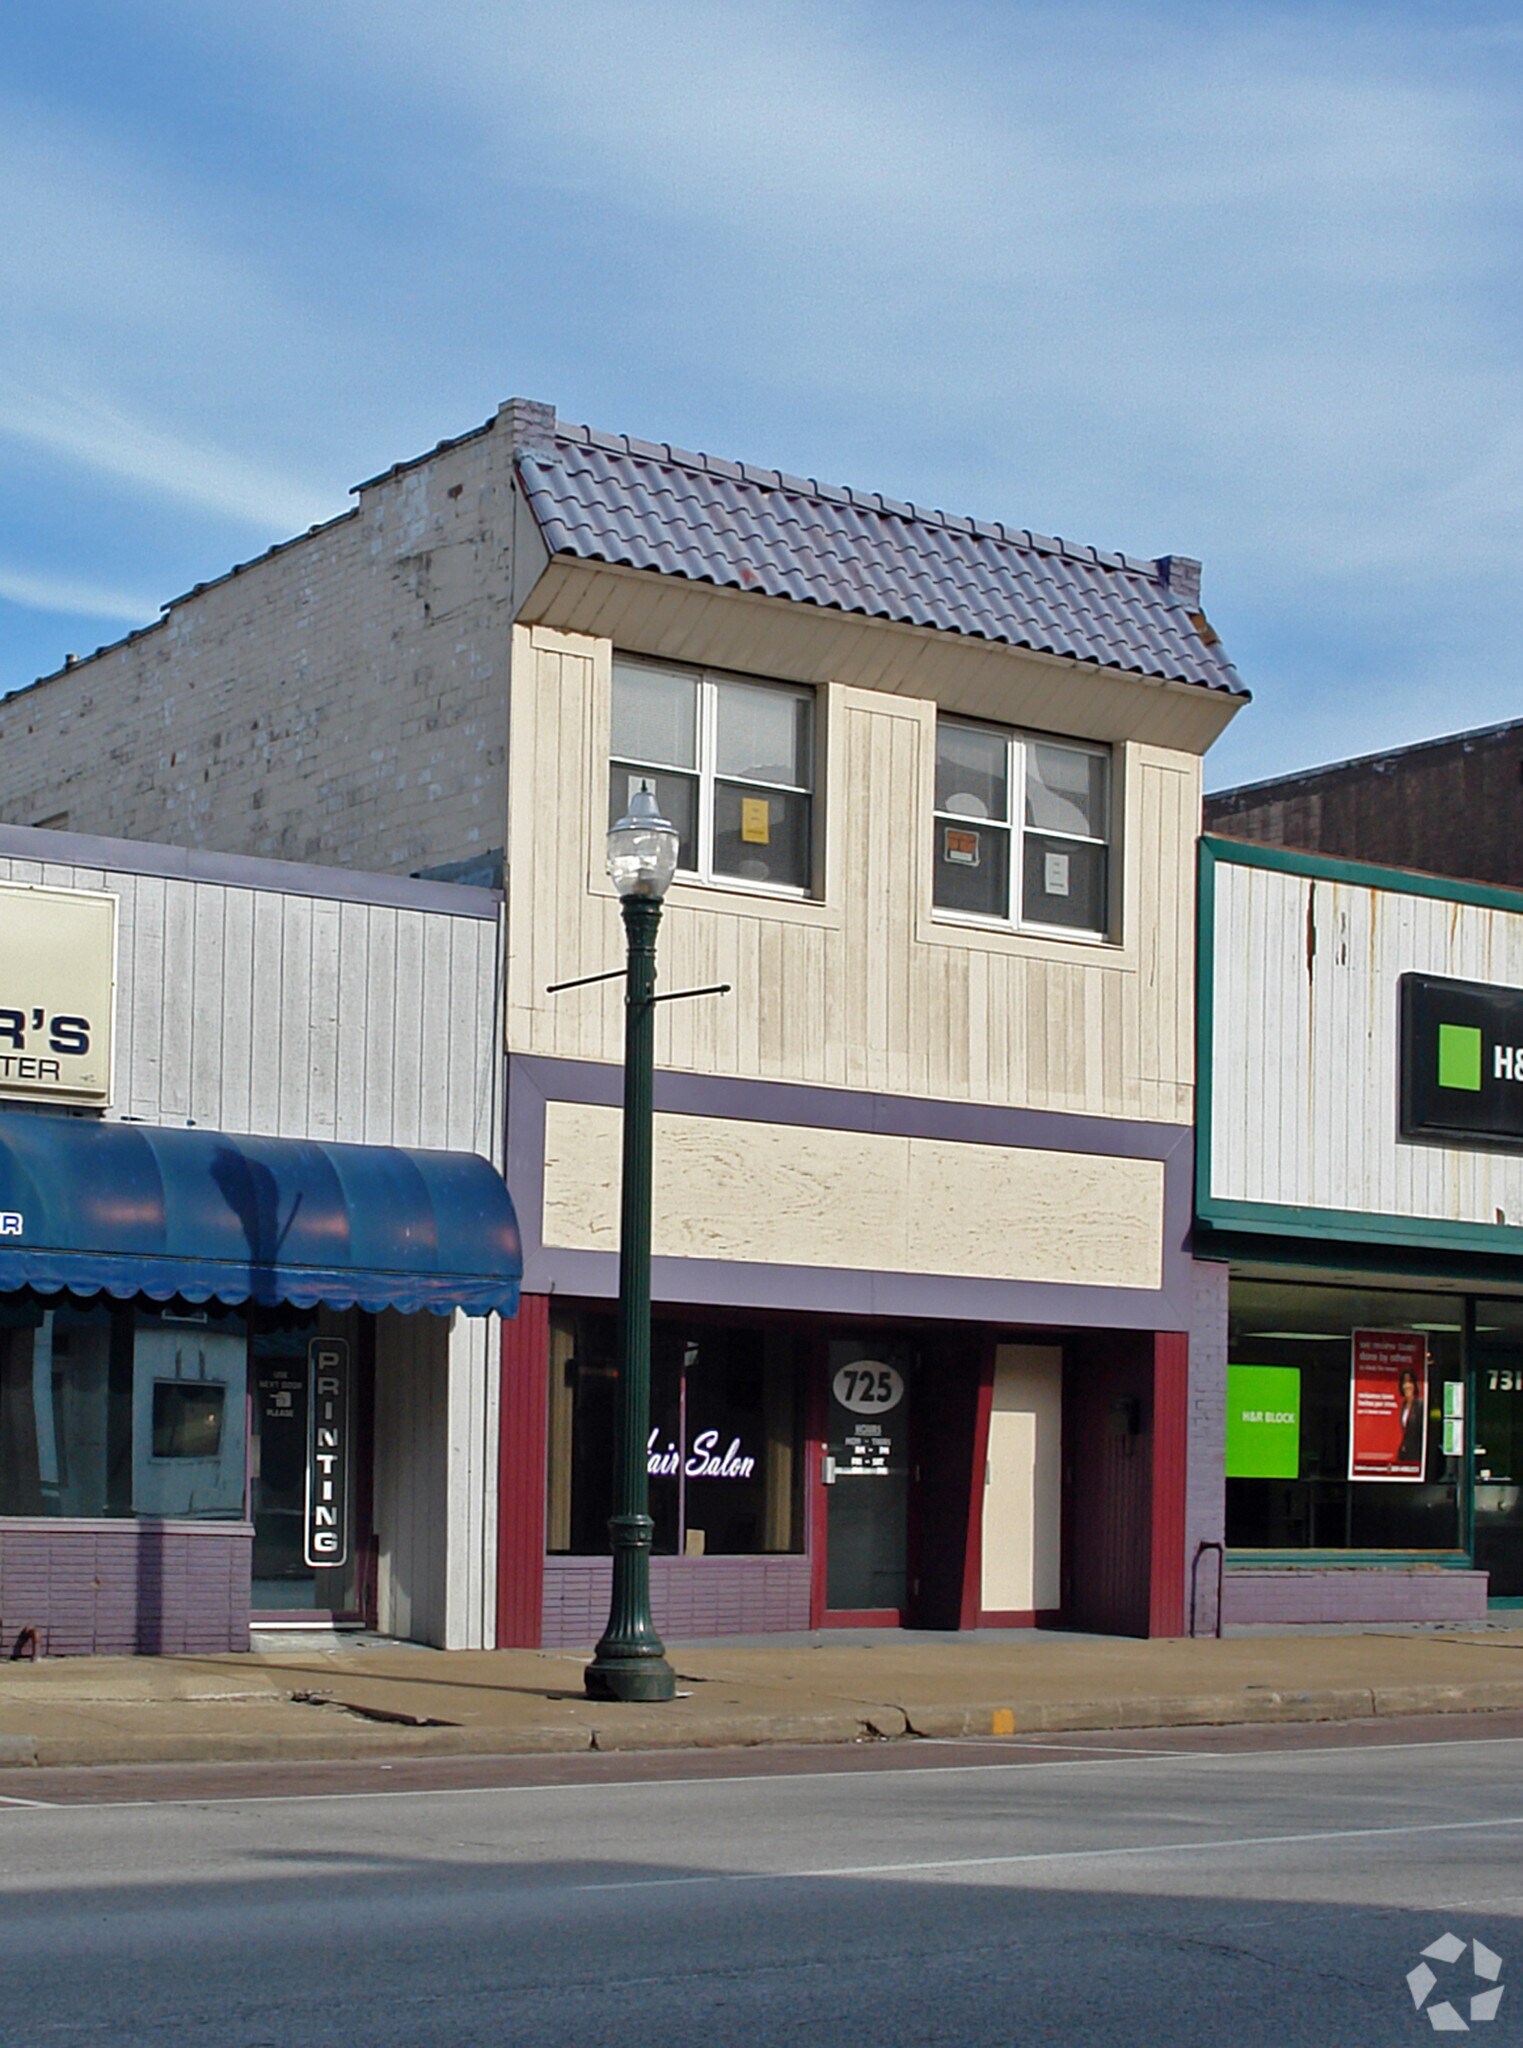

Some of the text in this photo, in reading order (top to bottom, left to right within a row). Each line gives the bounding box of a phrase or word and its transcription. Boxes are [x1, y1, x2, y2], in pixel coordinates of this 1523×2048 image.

[0, 1008, 91, 1056] R'S
[0, 1055, 60, 1081] TER
[843, 1370, 893, 1402] 725
[1487, 1369, 1522, 1391] 731
[1242, 1411, 1295, 1424] H&R BLOCK
[313, 1351, 340, 1552] PRINTING
[647, 1427, 755, 1478] air Salon
